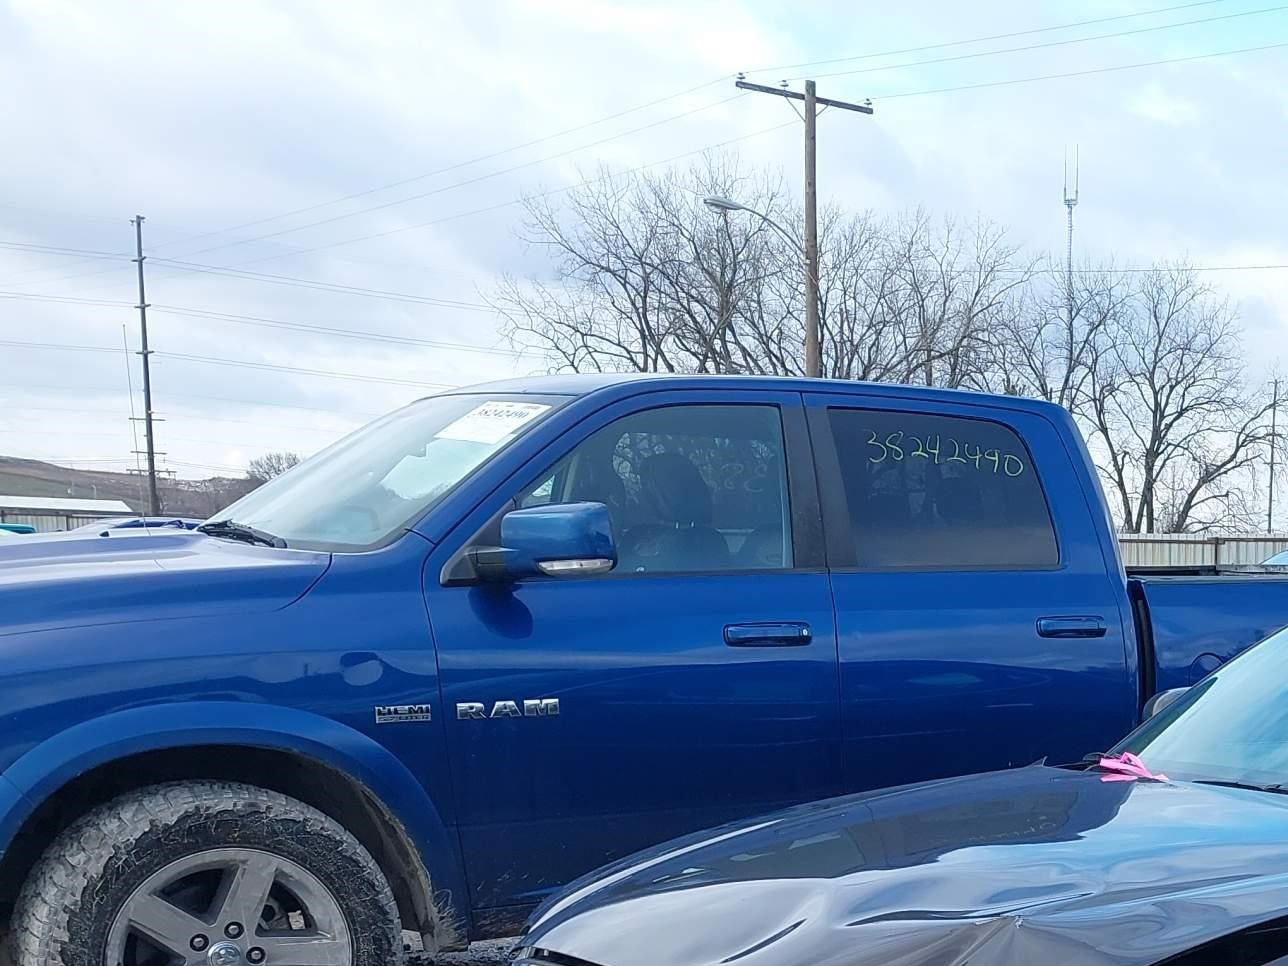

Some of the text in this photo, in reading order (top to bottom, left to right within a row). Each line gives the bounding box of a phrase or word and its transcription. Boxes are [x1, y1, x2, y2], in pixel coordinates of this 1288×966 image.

[867, 431, 1024, 477] 38242490
[377, 704, 431, 717] HEMI
[456, 698, 560, 719] RAM
